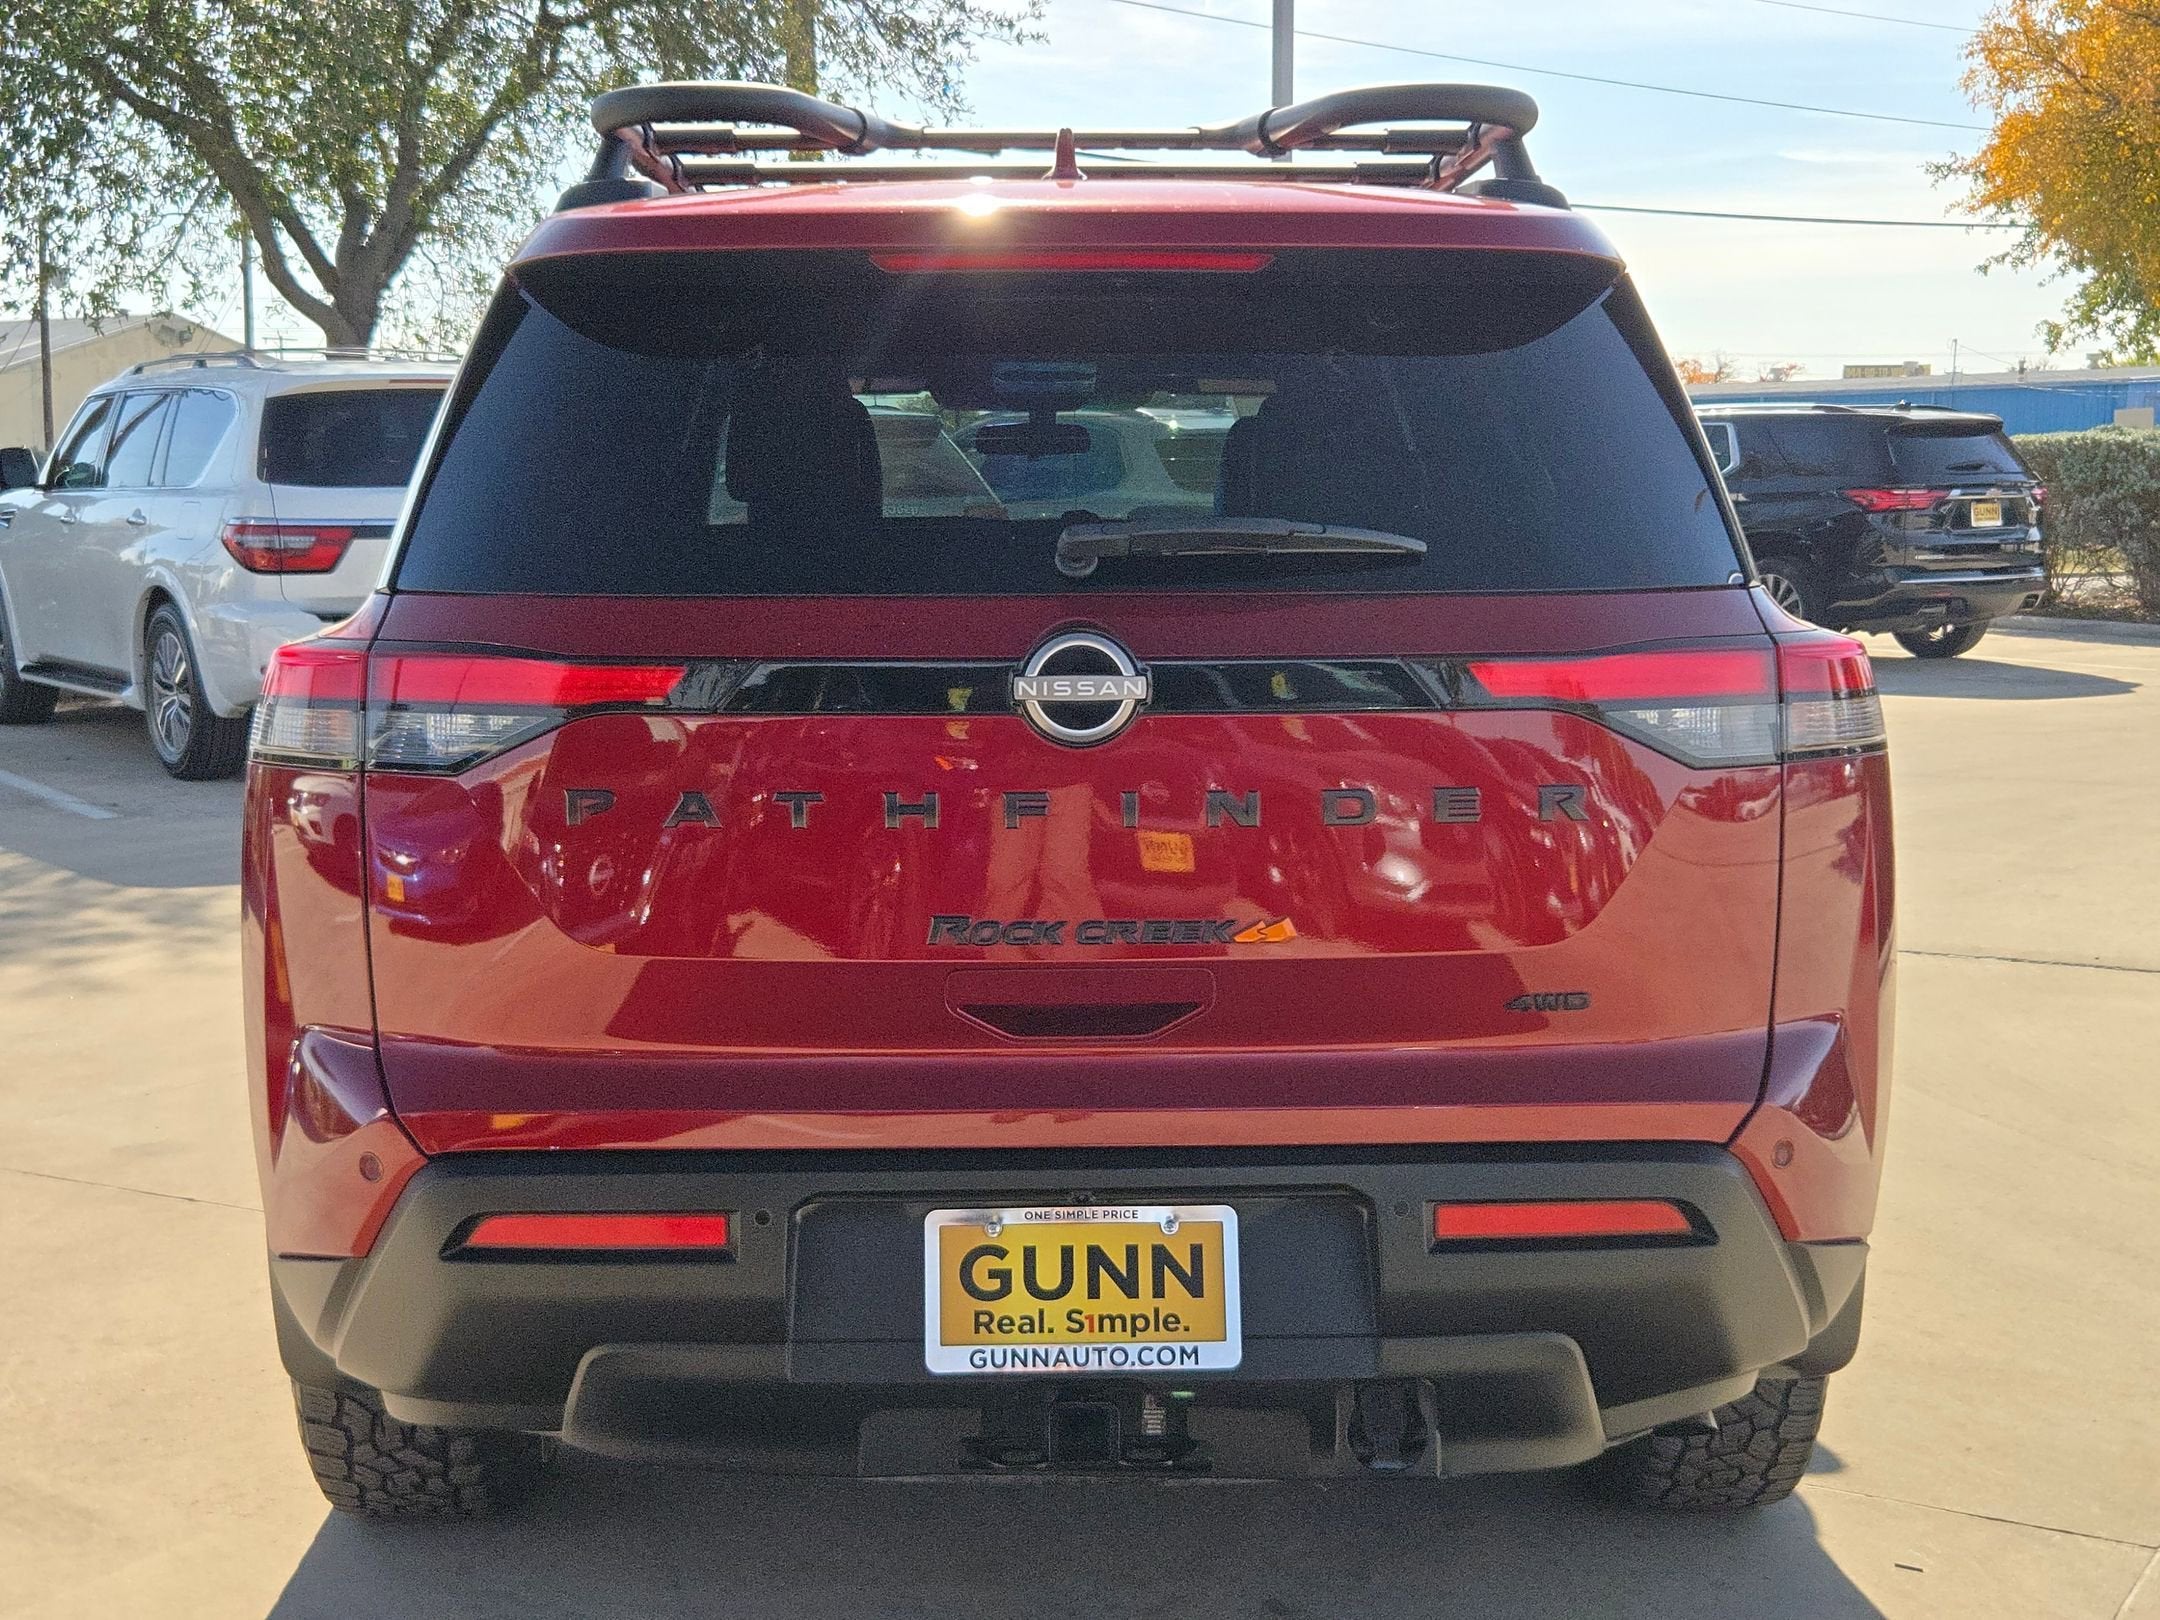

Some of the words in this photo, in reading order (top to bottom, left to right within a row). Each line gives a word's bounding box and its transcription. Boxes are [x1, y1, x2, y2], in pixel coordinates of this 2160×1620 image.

[1018, 681, 1142, 696] NISSAN
[564, 785, 1590, 829] PATHFINDER
[927, 915, 1068, 945] ROCK
[1075, 920, 1237, 945] CREEK
[1503, 992, 1590, 1011] 4WD
[1024, 1210, 1050, 1220] ONE
[1055, 1210, 1098, 1220] SIMPLE
[1103, 1209, 1139, 1219] PRICE
[959, 1243, 1204, 1301] GUNN
[973, 1308, 1054, 1334] Real.
[969, 1345, 1199, 1369] GUNNAUTO.COM
